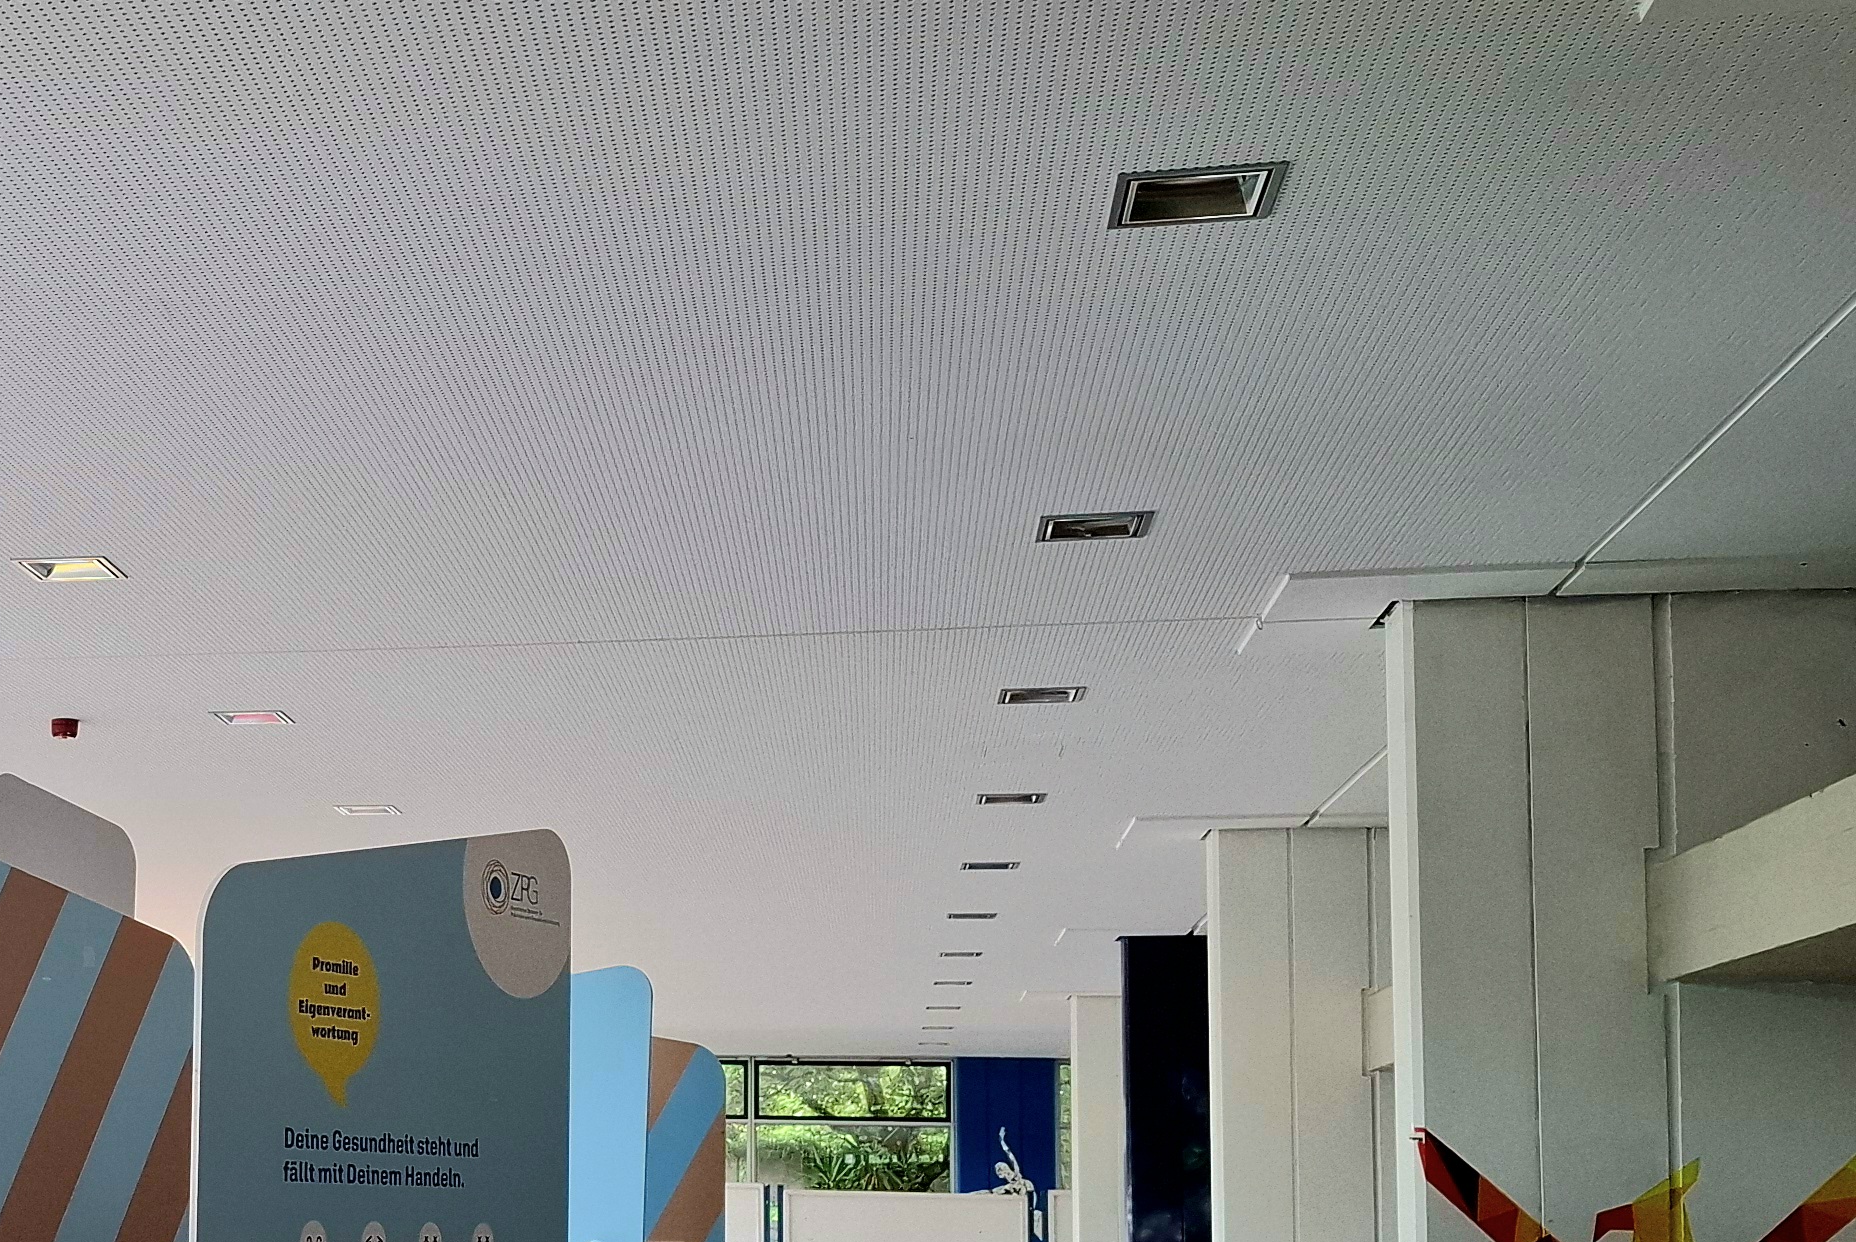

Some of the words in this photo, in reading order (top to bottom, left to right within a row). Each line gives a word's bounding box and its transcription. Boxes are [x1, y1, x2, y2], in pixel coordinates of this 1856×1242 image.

[510, 871, 539, 905] ZPG
[312, 956, 359, 976] Promille
[324, 982, 347, 996] und
[298, 999, 371, 1020] Eigenverant-
[311, 1025, 359, 1046] wortung
[284, 1126, 329, 1150] Deine
[332, 1129, 415, 1155] Gesundheit
[417, 1135, 452, 1156] steht
[454, 1138, 479, 1158] und
[283, 1160, 315, 1182] fällt
[318, 1162, 344, 1184] mit
[347, 1164, 402, 1186] Deinem
[405, 1165, 465, 1188] Handeln.
